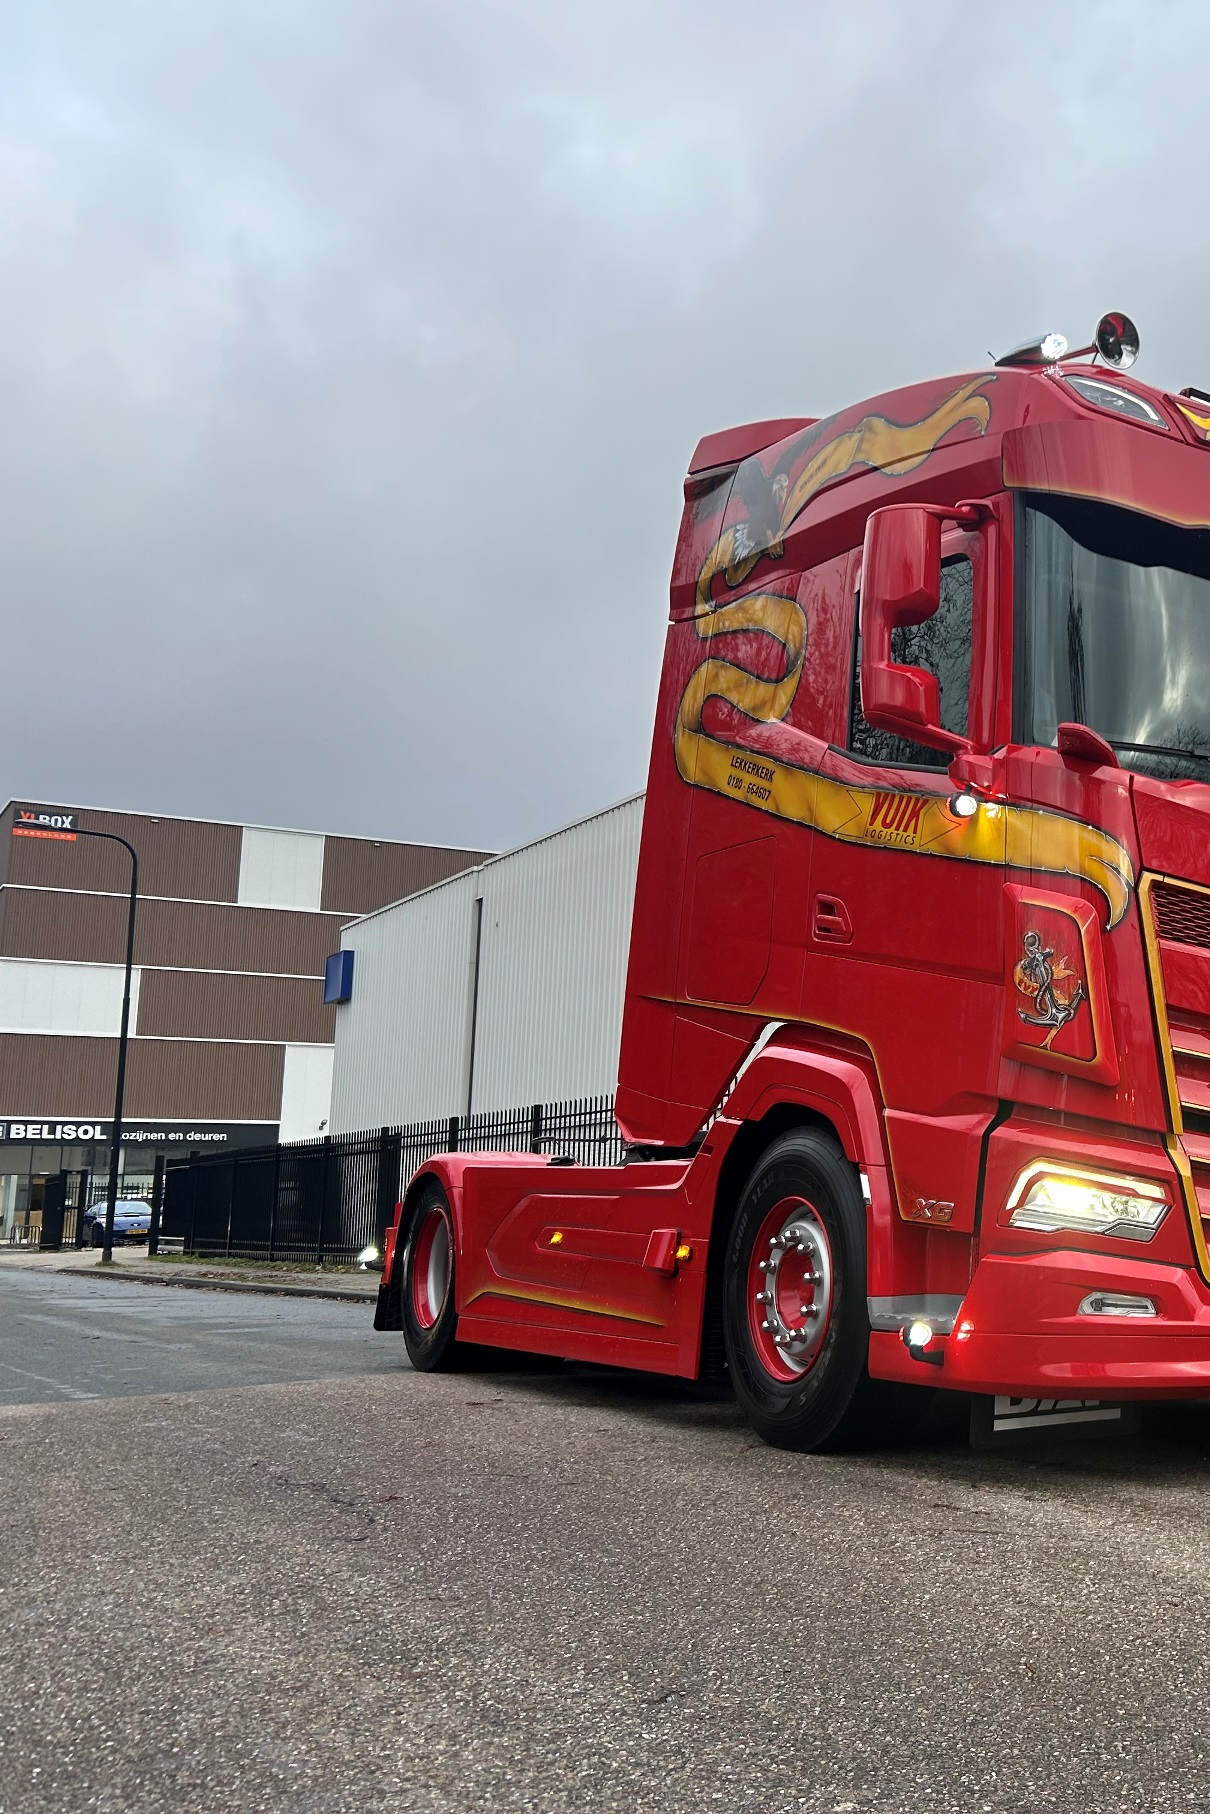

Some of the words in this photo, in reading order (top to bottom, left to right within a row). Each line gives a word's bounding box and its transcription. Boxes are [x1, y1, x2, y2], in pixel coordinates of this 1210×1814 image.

[731, 755, 775, 783] LEKKERKERK
[727, 774, 743, 790] 0180
[869, 791, 929, 835] VUIK
[865, 828, 917, 846] LOGISTICS
[9, 1123, 107, 1140] BELISOL
[120, 1130, 165, 1142] ozijnen
[168, 1132, 183, 1140] en
[186, 1131, 227, 1141] deuren
